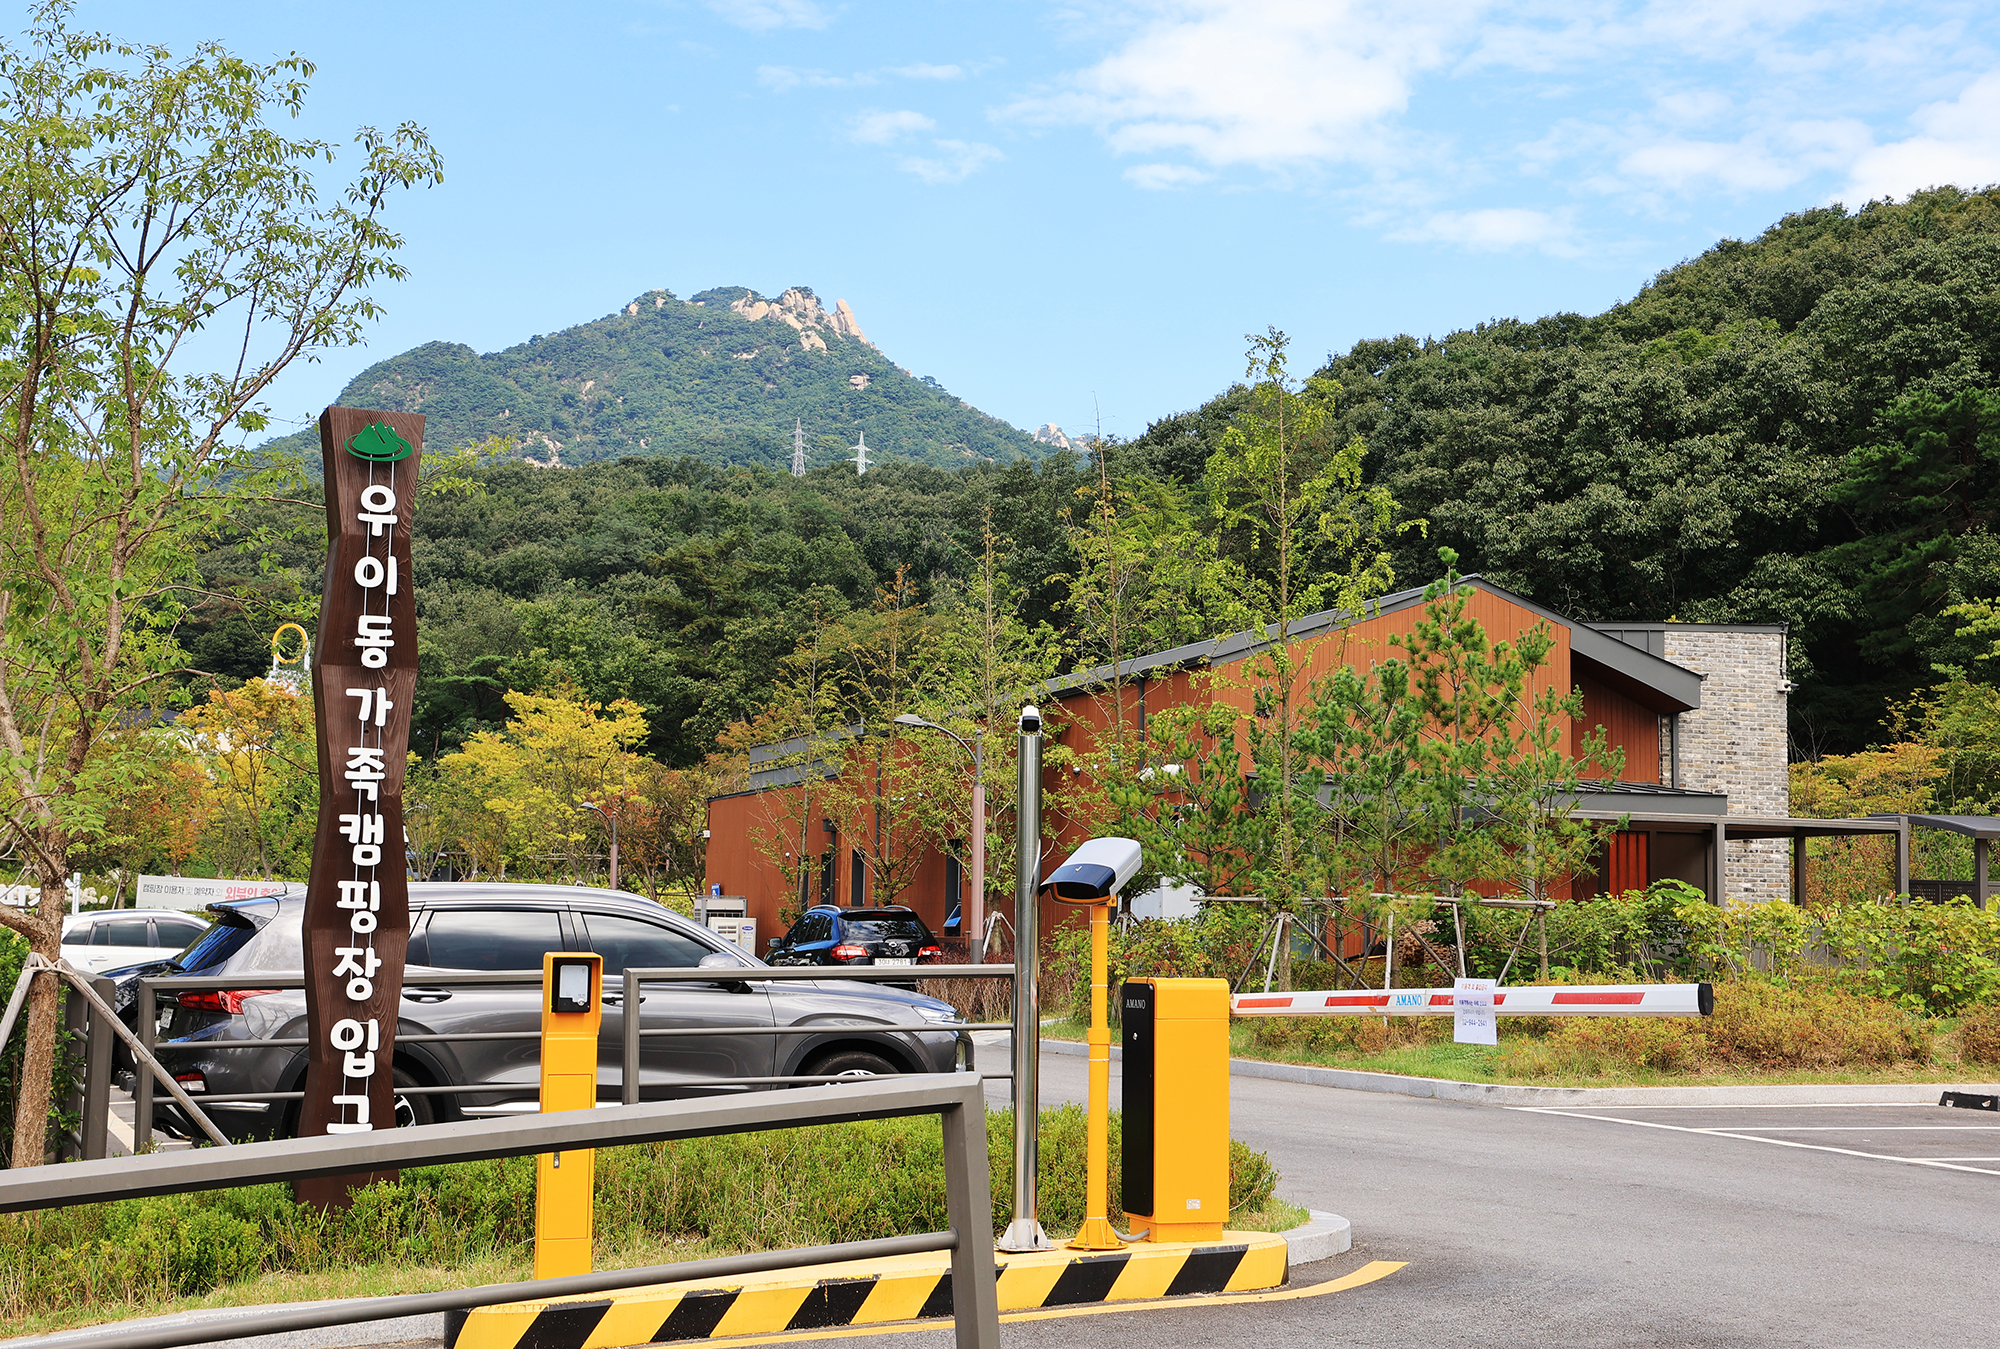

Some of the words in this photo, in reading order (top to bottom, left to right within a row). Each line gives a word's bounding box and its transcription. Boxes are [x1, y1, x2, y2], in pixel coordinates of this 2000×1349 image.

[142, 883, 163, 894] 캠핑장
[164, 884, 185, 895] 이용자
[194, 886, 215, 896] 예약자
[1125, 998, 1146, 1010] AMANO
[1396, 994, 1422, 1006] AMANO
